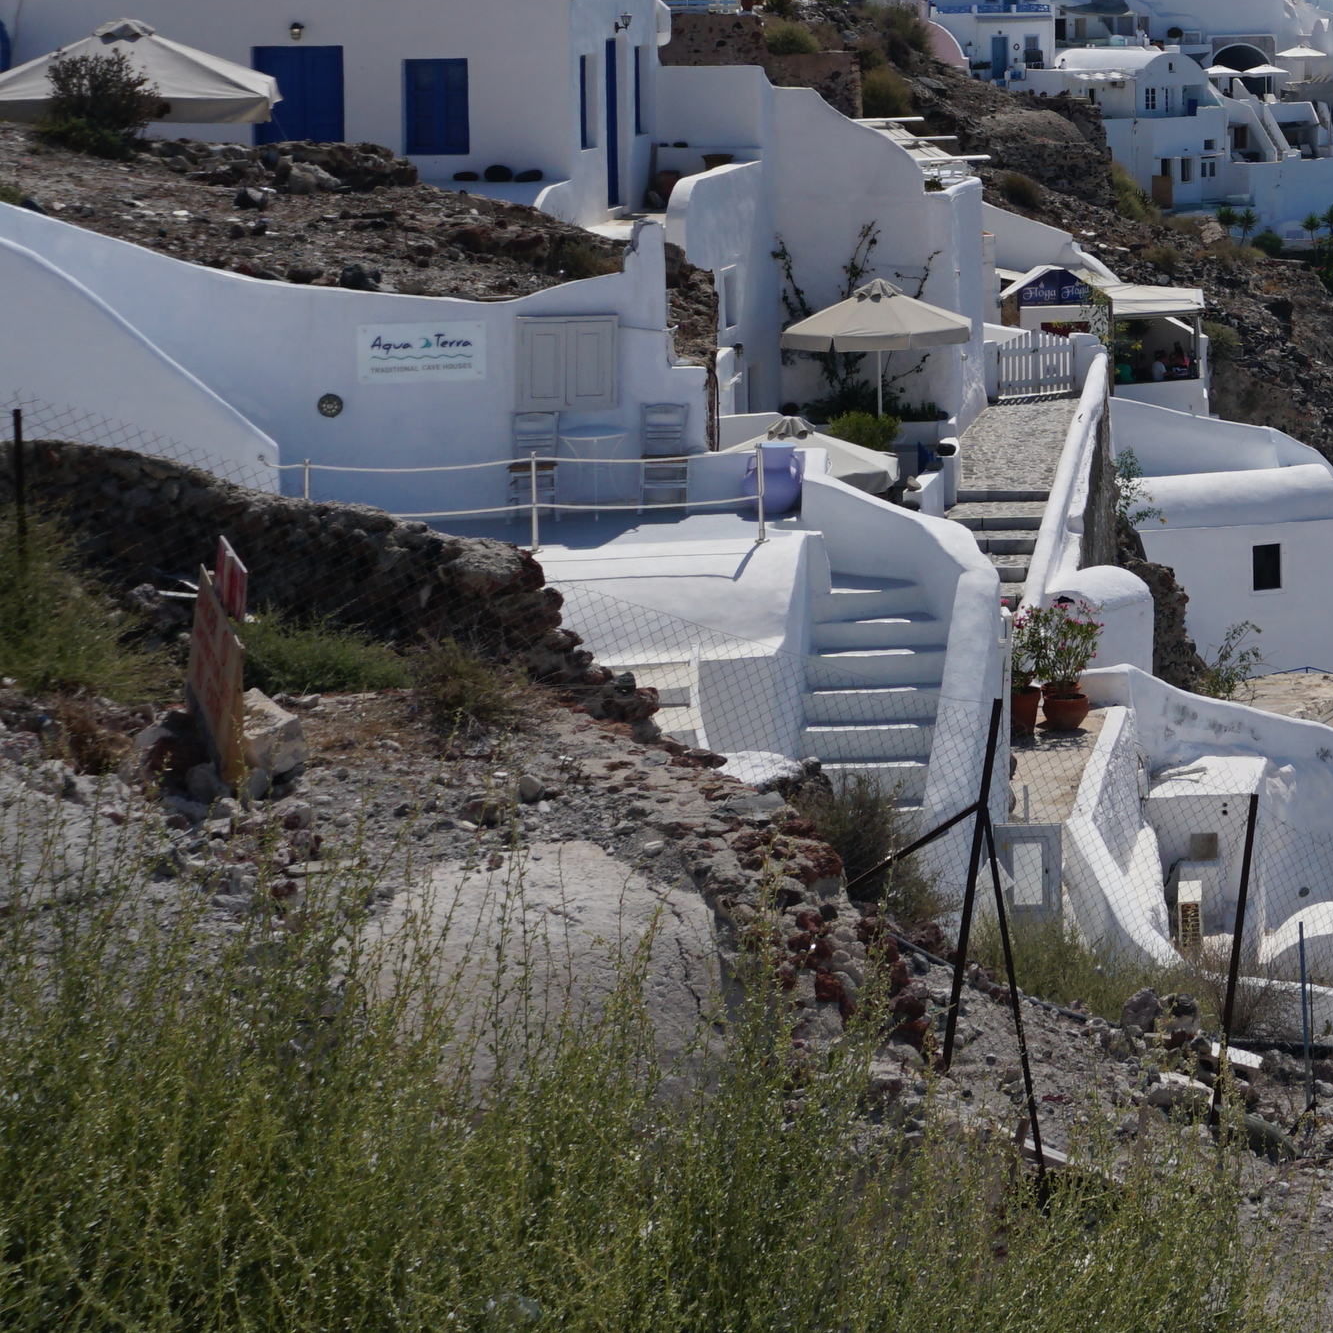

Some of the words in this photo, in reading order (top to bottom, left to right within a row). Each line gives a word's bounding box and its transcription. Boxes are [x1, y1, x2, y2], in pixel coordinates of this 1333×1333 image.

[1023, 287, 1056, 301] Floga
[371, 335, 413, 355] Aqua
[434, 333, 473, 348] Terra
[371, 365, 419, 374] TRADITIONAL
[443, 362, 472, 370] HOUSES
